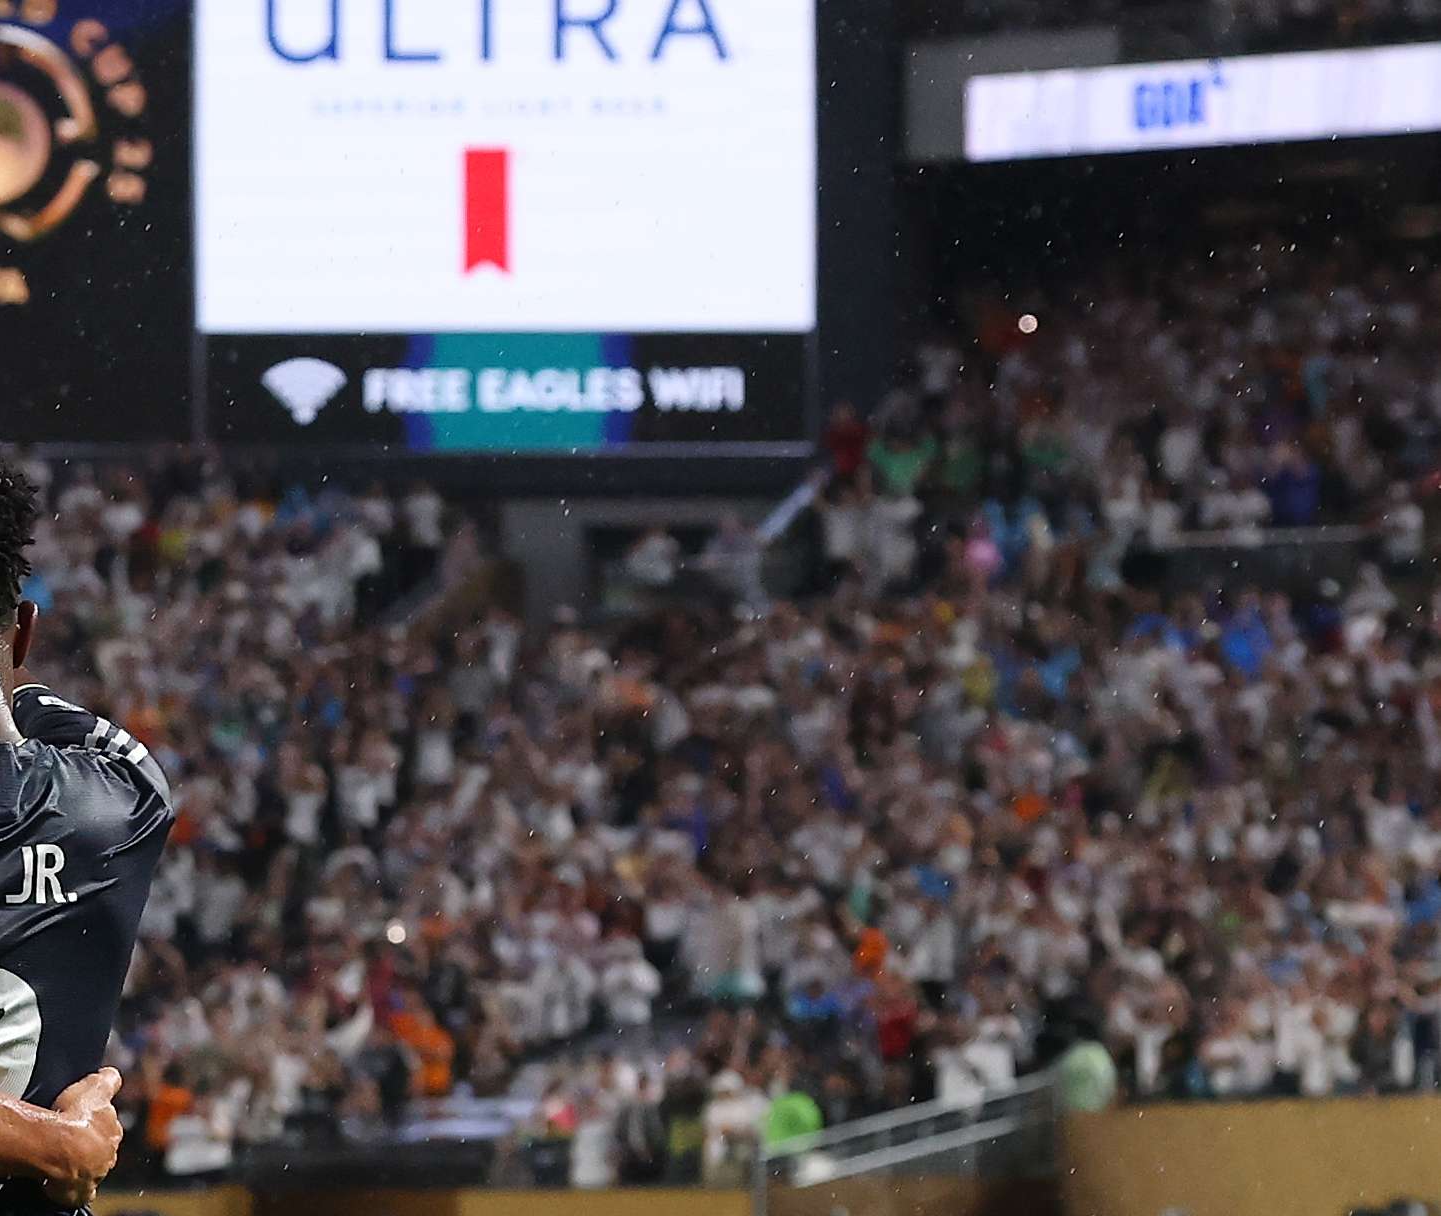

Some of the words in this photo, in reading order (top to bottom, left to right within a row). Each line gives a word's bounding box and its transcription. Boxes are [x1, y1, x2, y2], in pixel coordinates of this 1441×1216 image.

[363, 367, 473, 413] FREE
[476, 367, 645, 413] EAGLES
[5, 842, 78, 906] JR.
